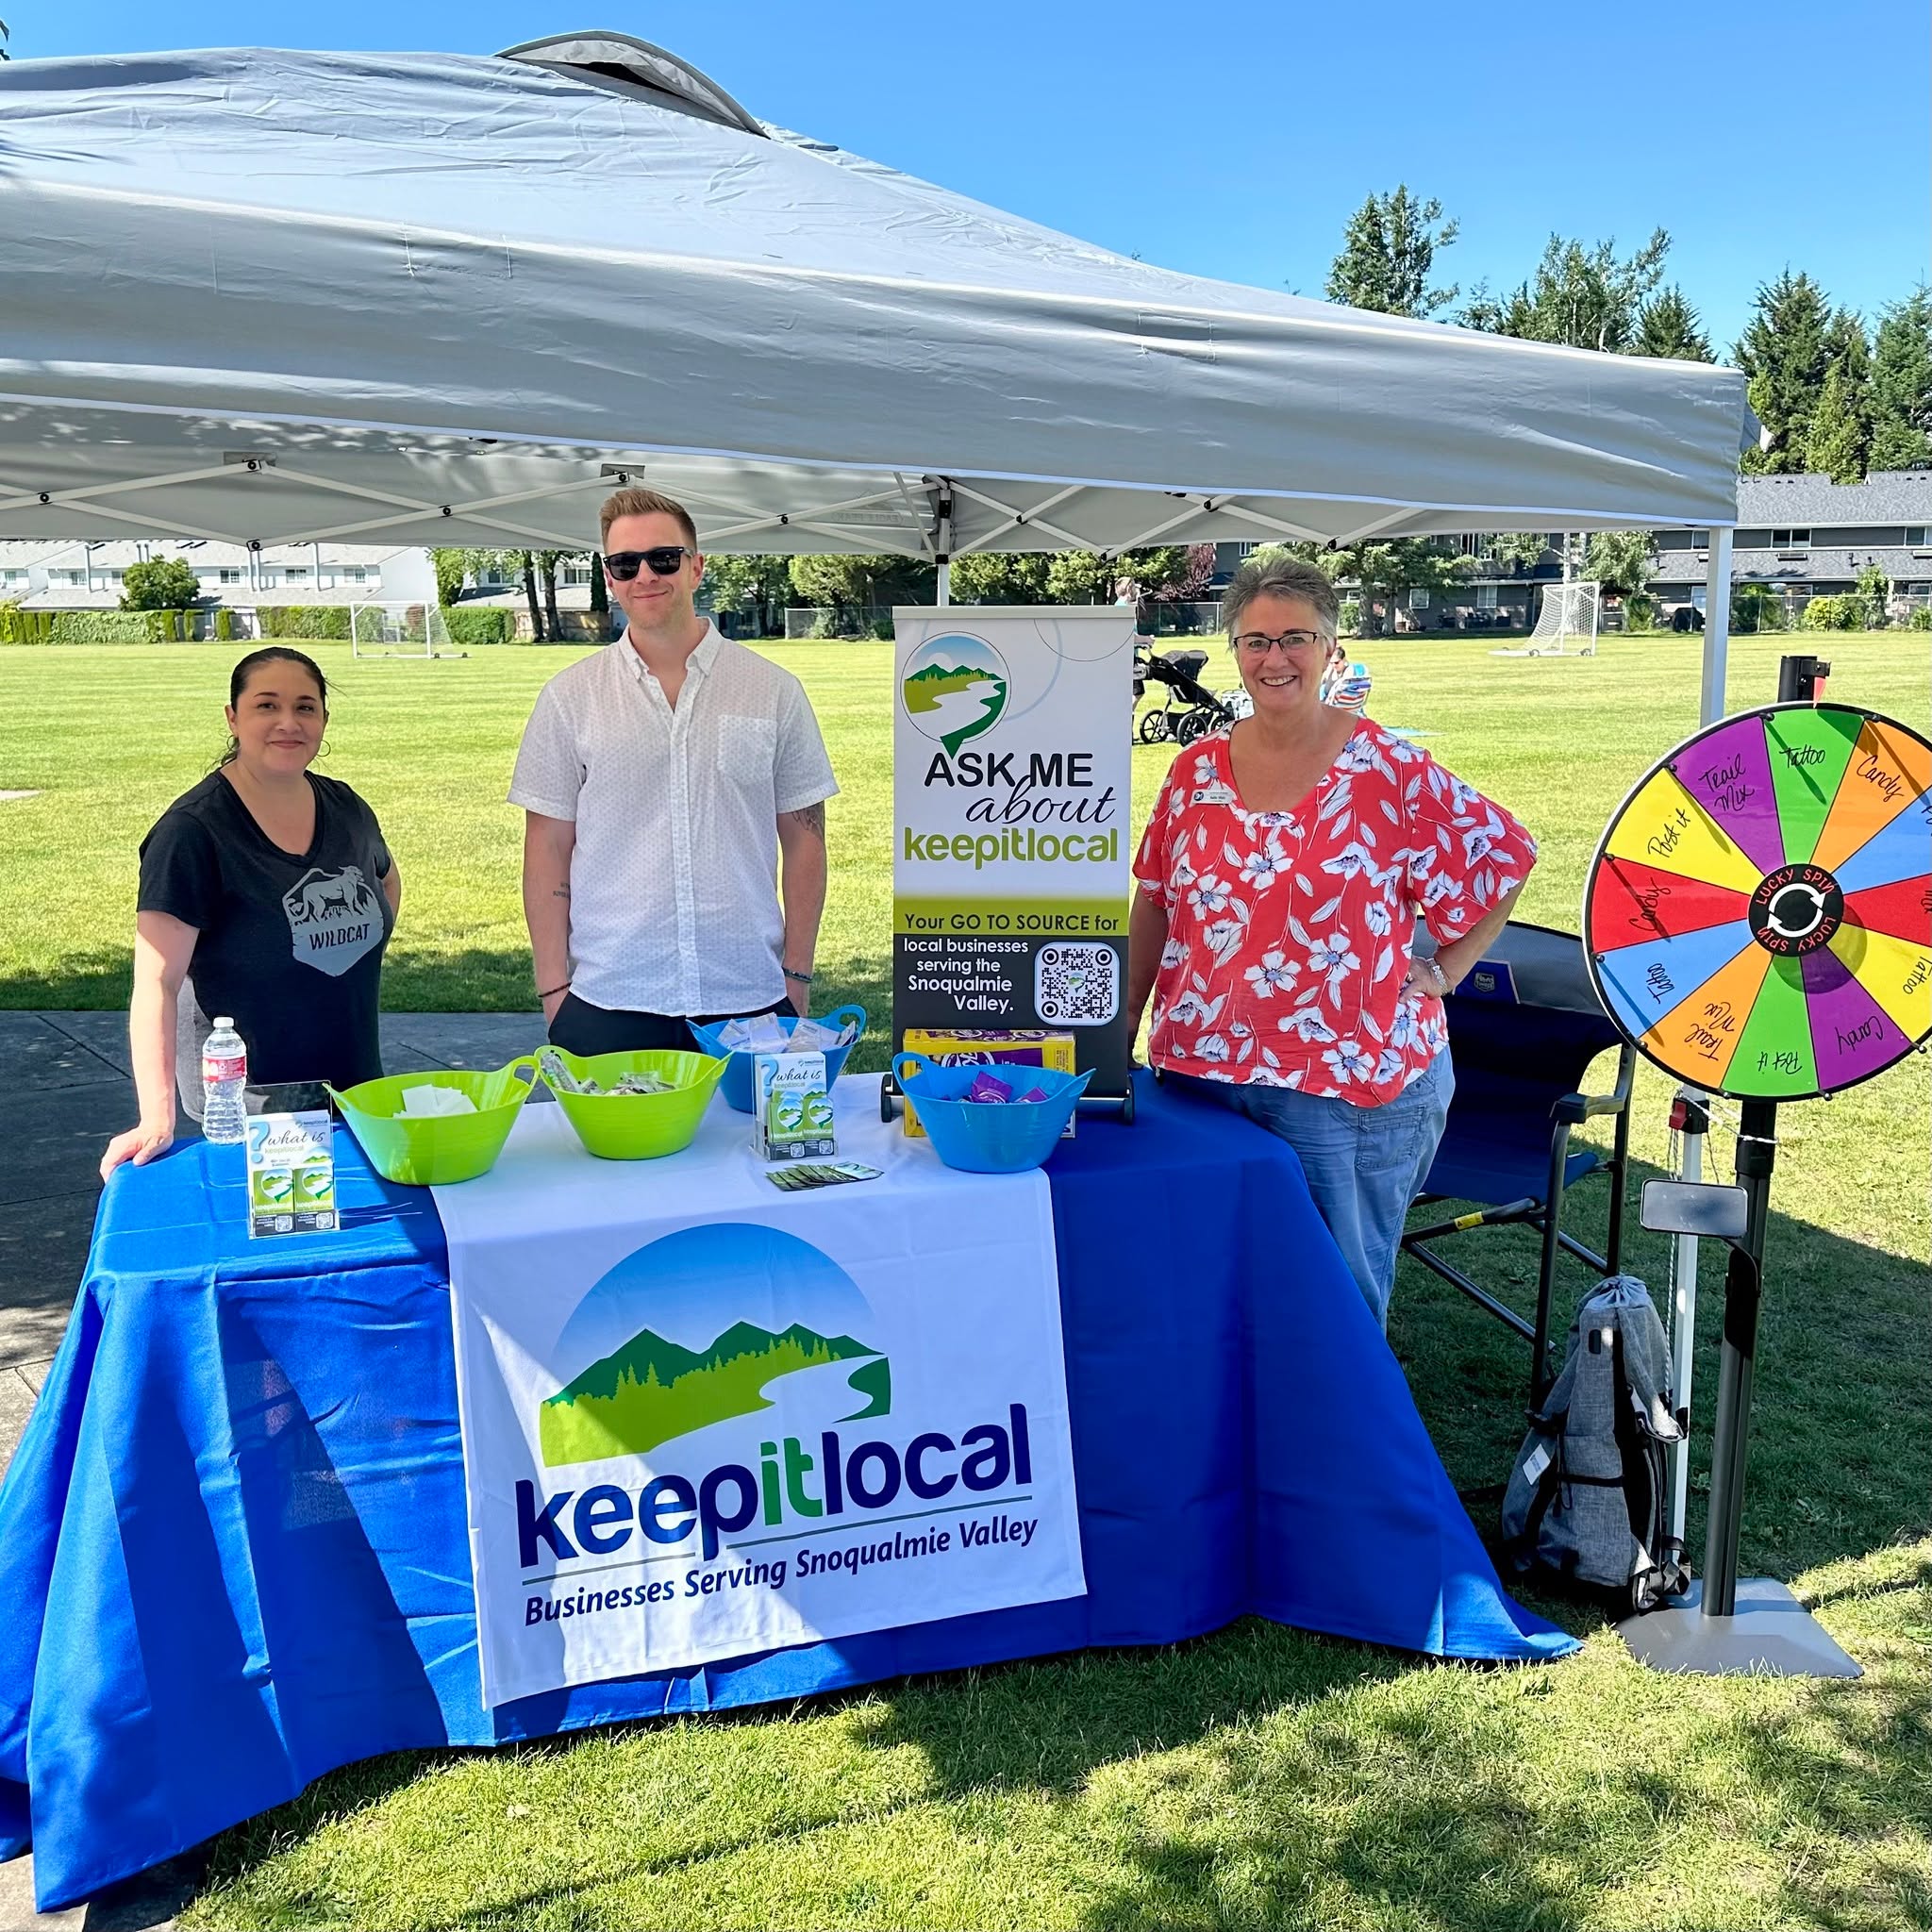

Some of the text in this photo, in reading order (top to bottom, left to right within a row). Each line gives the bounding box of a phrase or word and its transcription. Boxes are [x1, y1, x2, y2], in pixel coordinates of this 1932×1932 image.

[924, 753, 1093, 787] ASK ME
[1698, 754, 1745, 792] Trail
[1779, 747, 1825, 769] Tattoo
[1715, 781, 1755, 811] Mix
[1857, 755, 1905, 802] Candy
[966, 774, 1116, 824] about
[904, 826, 1118, 870] keepitlocal
[1647, 808, 1691, 858] Post it
[1628, 877, 1672, 931] Candy
[1756, 869, 1835, 905] LUCKY SPIN
[309, 924, 371, 951] WILDCAT
[905, 914, 1119, 930] Your GO TO SOURCE for
[1757, 916, 1837, 952] LUCKY SPIN
[904, 938, 1028, 953] local businesses
[917, 958, 1001, 974] serving the
[908, 975, 1013, 994] Snoqualmie
[1647, 963, 1675, 1005] Tattoo
[954, 995, 1014, 1014] Valley.
[1835, 1015, 1884, 1055] Candy
[776, 1068, 822, 1081] what is
[1757, 1051, 1803, 1074] Post it
[268, 1129, 325, 1145] what is
[515, 1403, 1032, 1568] keepitlocal
[524, 1516, 1038, 1626] Businesses Serving Snoqualmie Valley
